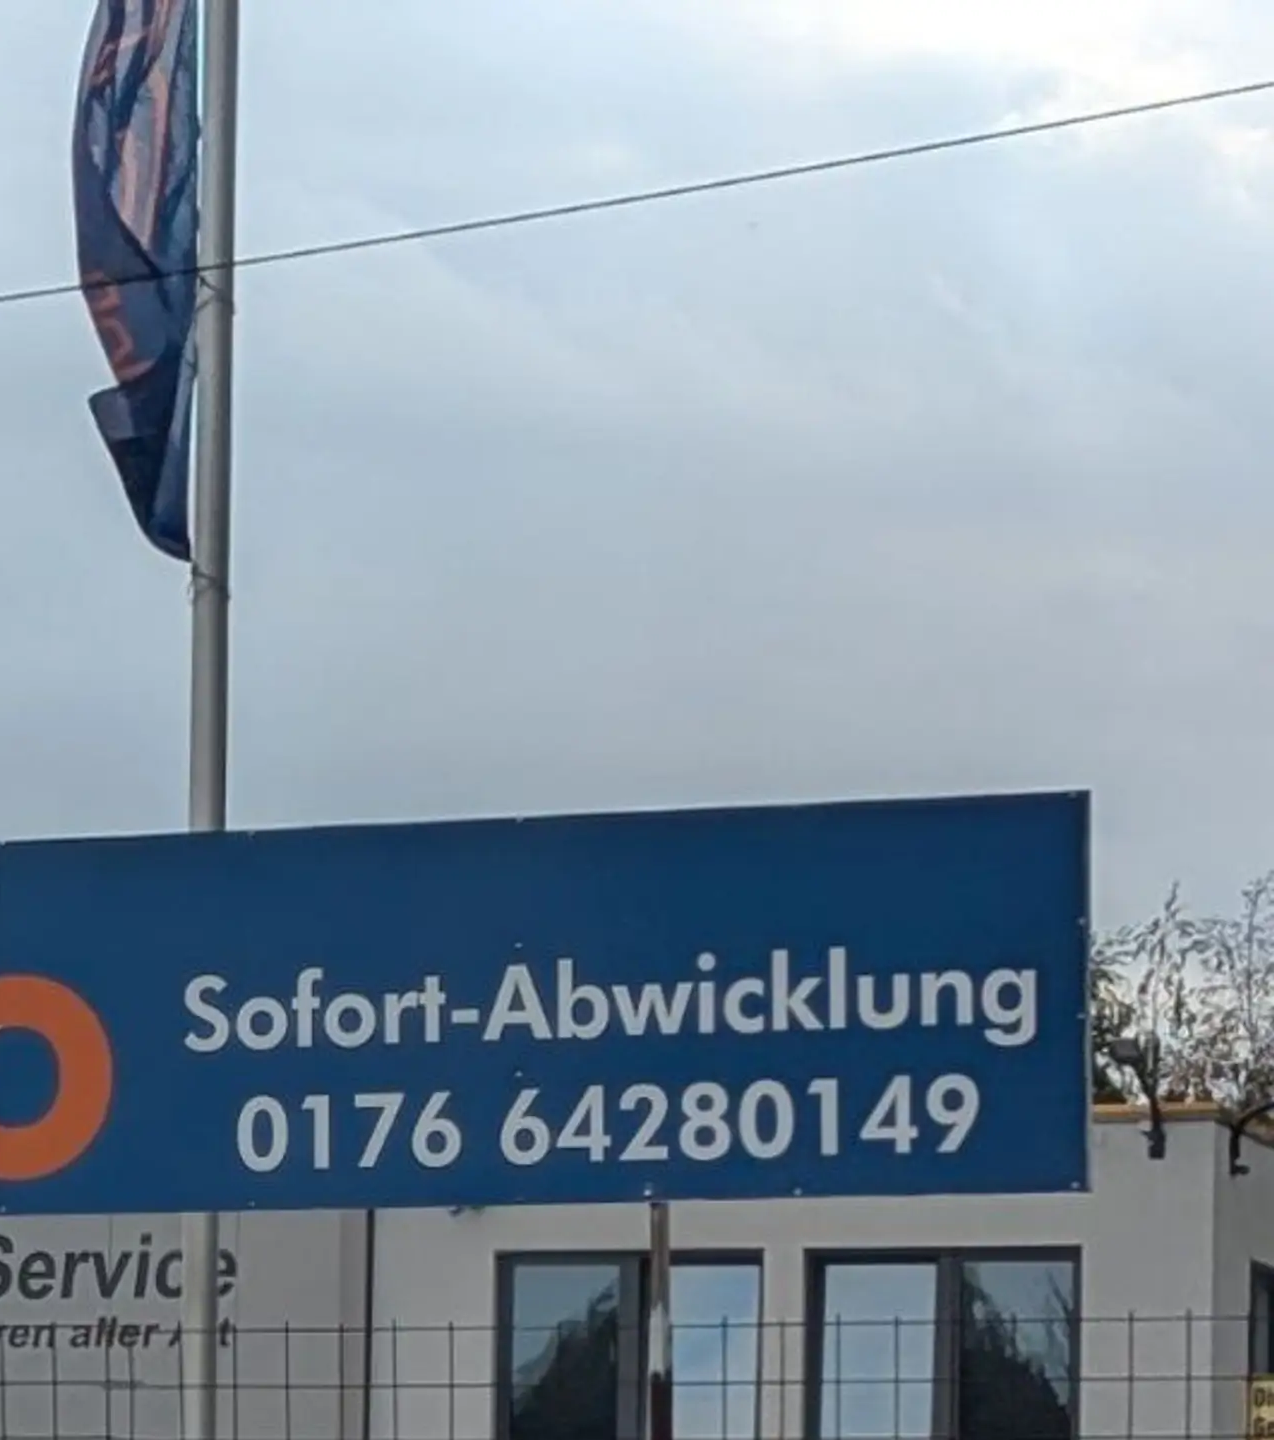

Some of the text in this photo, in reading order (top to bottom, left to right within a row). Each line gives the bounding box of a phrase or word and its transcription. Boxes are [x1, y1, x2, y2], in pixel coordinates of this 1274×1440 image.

[183, 947, 1037, 1051] Sofort-Abwicklung
[237, 1074, 980, 1172] 0176 64280149
[70, 1316, 158, 1349] aller
